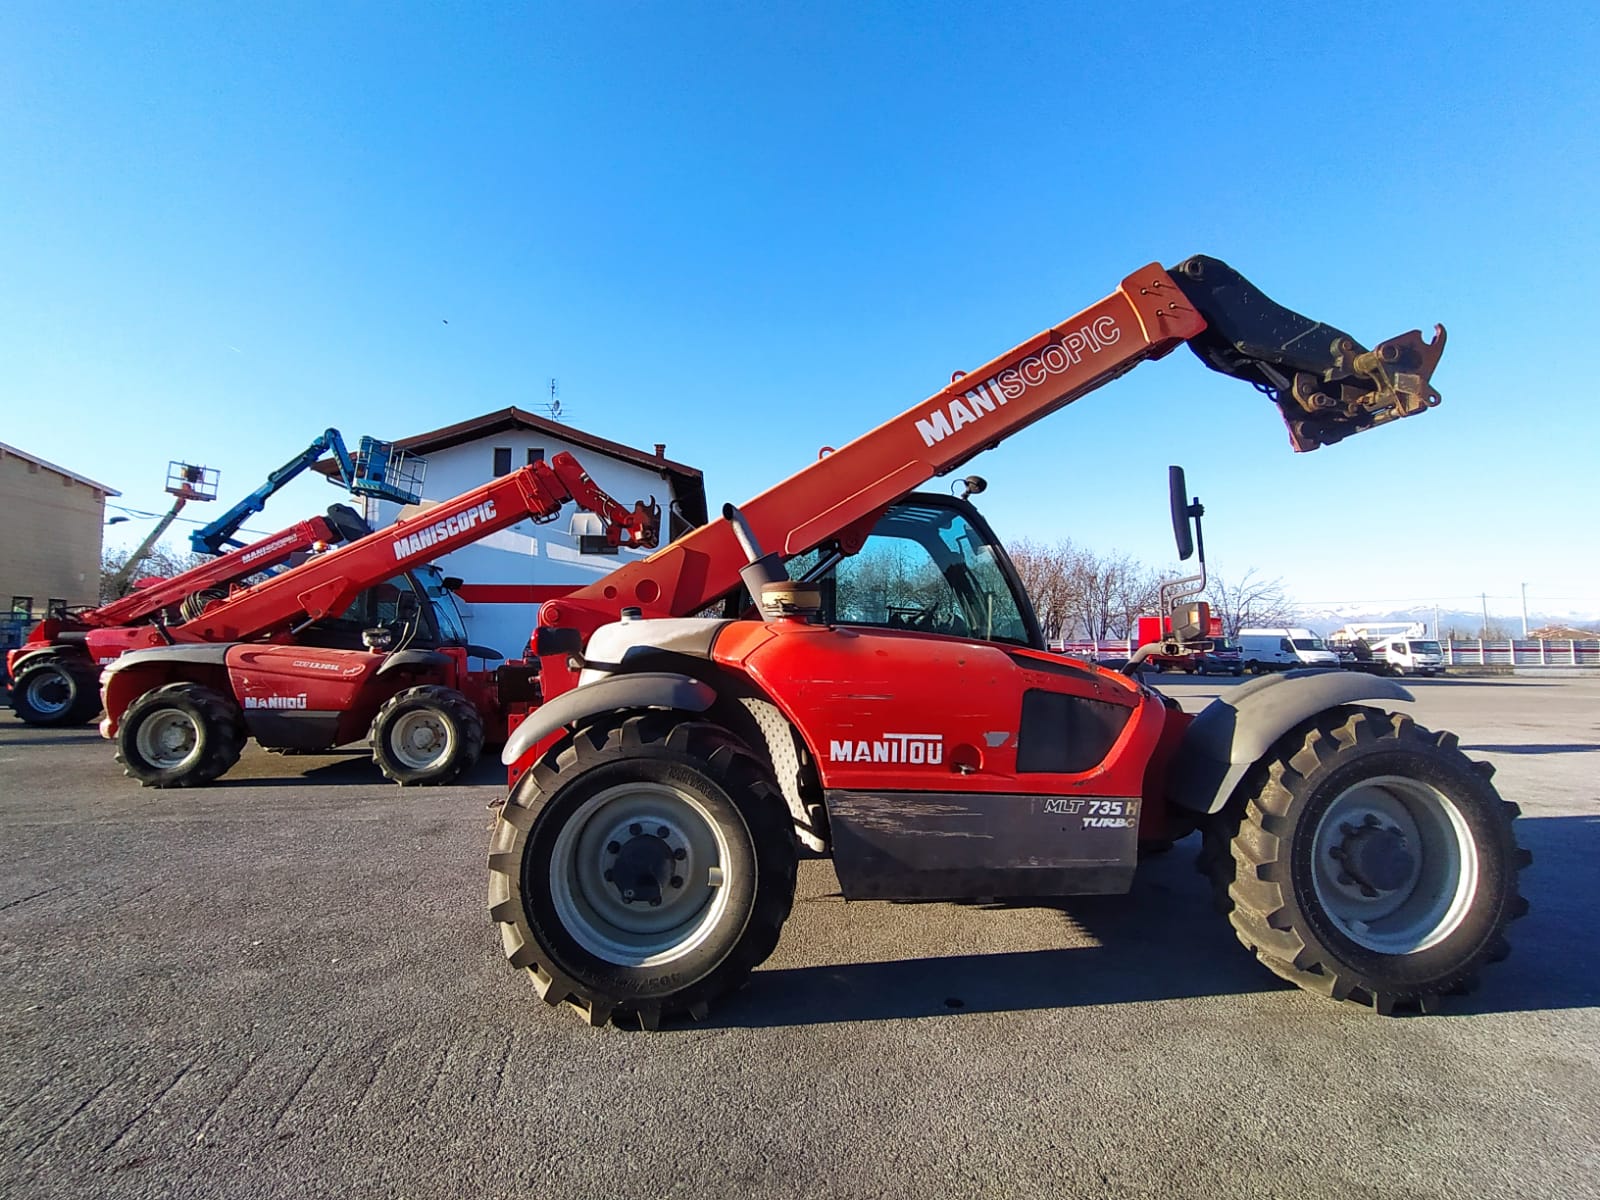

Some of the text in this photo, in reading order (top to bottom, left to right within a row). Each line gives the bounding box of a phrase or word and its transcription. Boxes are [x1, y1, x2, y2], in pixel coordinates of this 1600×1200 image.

[914, 316, 1120, 447] MANISCOPIC
[393, 500, 497, 560] MANISCOPIC
[244, 692, 307, 709] MANITOU
[830, 733, 943, 765] MANITOU
[1043, 799, 1085, 814] MLT
[1088, 800, 1123, 816] 735
